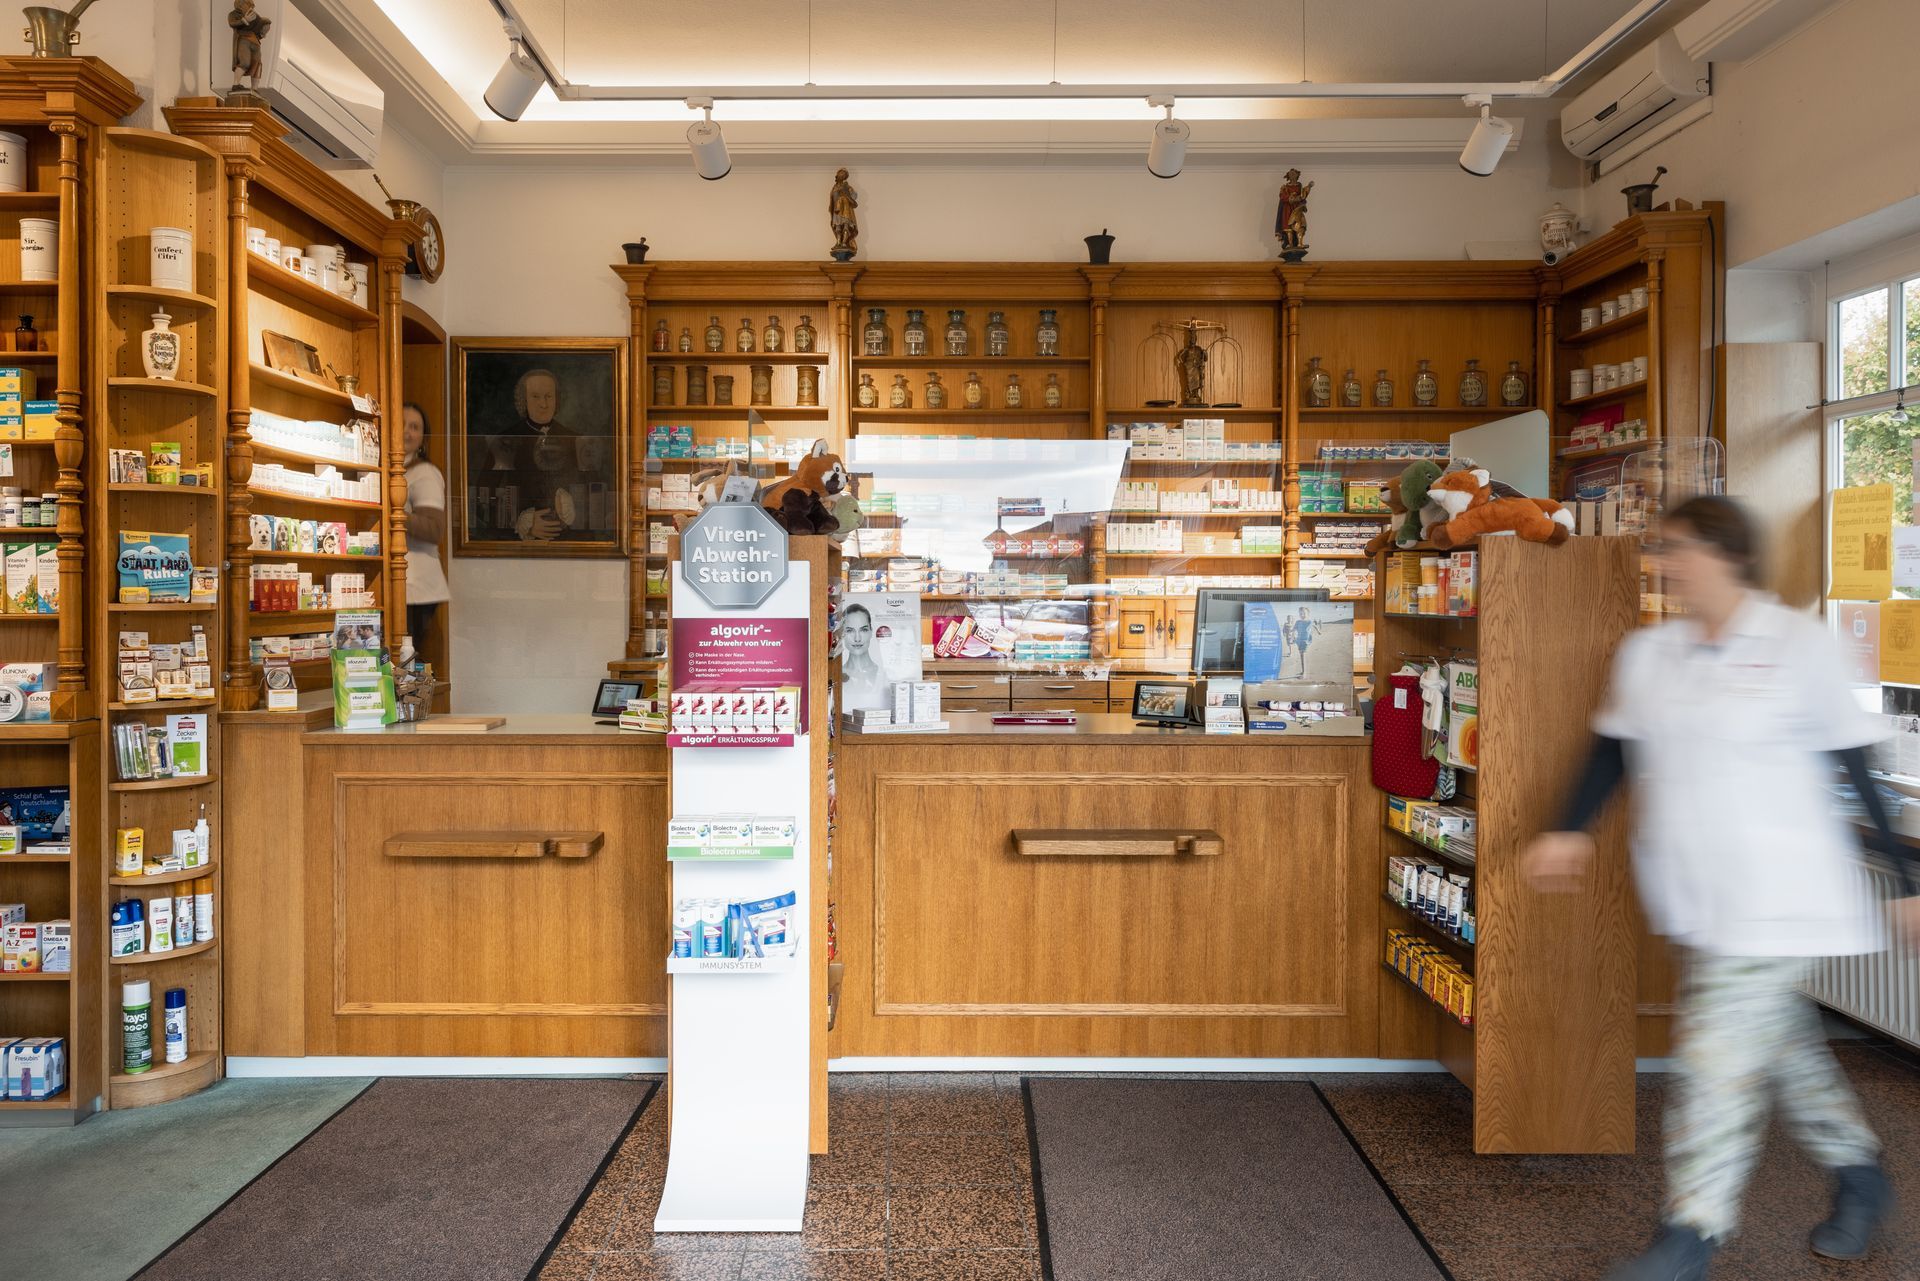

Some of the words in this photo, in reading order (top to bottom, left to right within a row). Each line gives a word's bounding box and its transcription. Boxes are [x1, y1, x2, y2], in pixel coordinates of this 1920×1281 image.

[153, 246, 184, 255] Confect.
[157, 252, 177, 261] Citri
[704, 526, 766, 542] Viren-
[692, 547, 778, 563] Abwehr-
[122, 558, 158, 570] STADT,
[161, 558, 191, 572] LAND,
[144, 568, 184, 580] Ruhe.
[700, 567, 773, 583] Station
[977, 628, 994, 643] doc
[936, 640, 948, 653] doc
[950, 635, 963, 652] doc
[718, 735, 780, 743] ERKÄLTUNGSSPRAY
